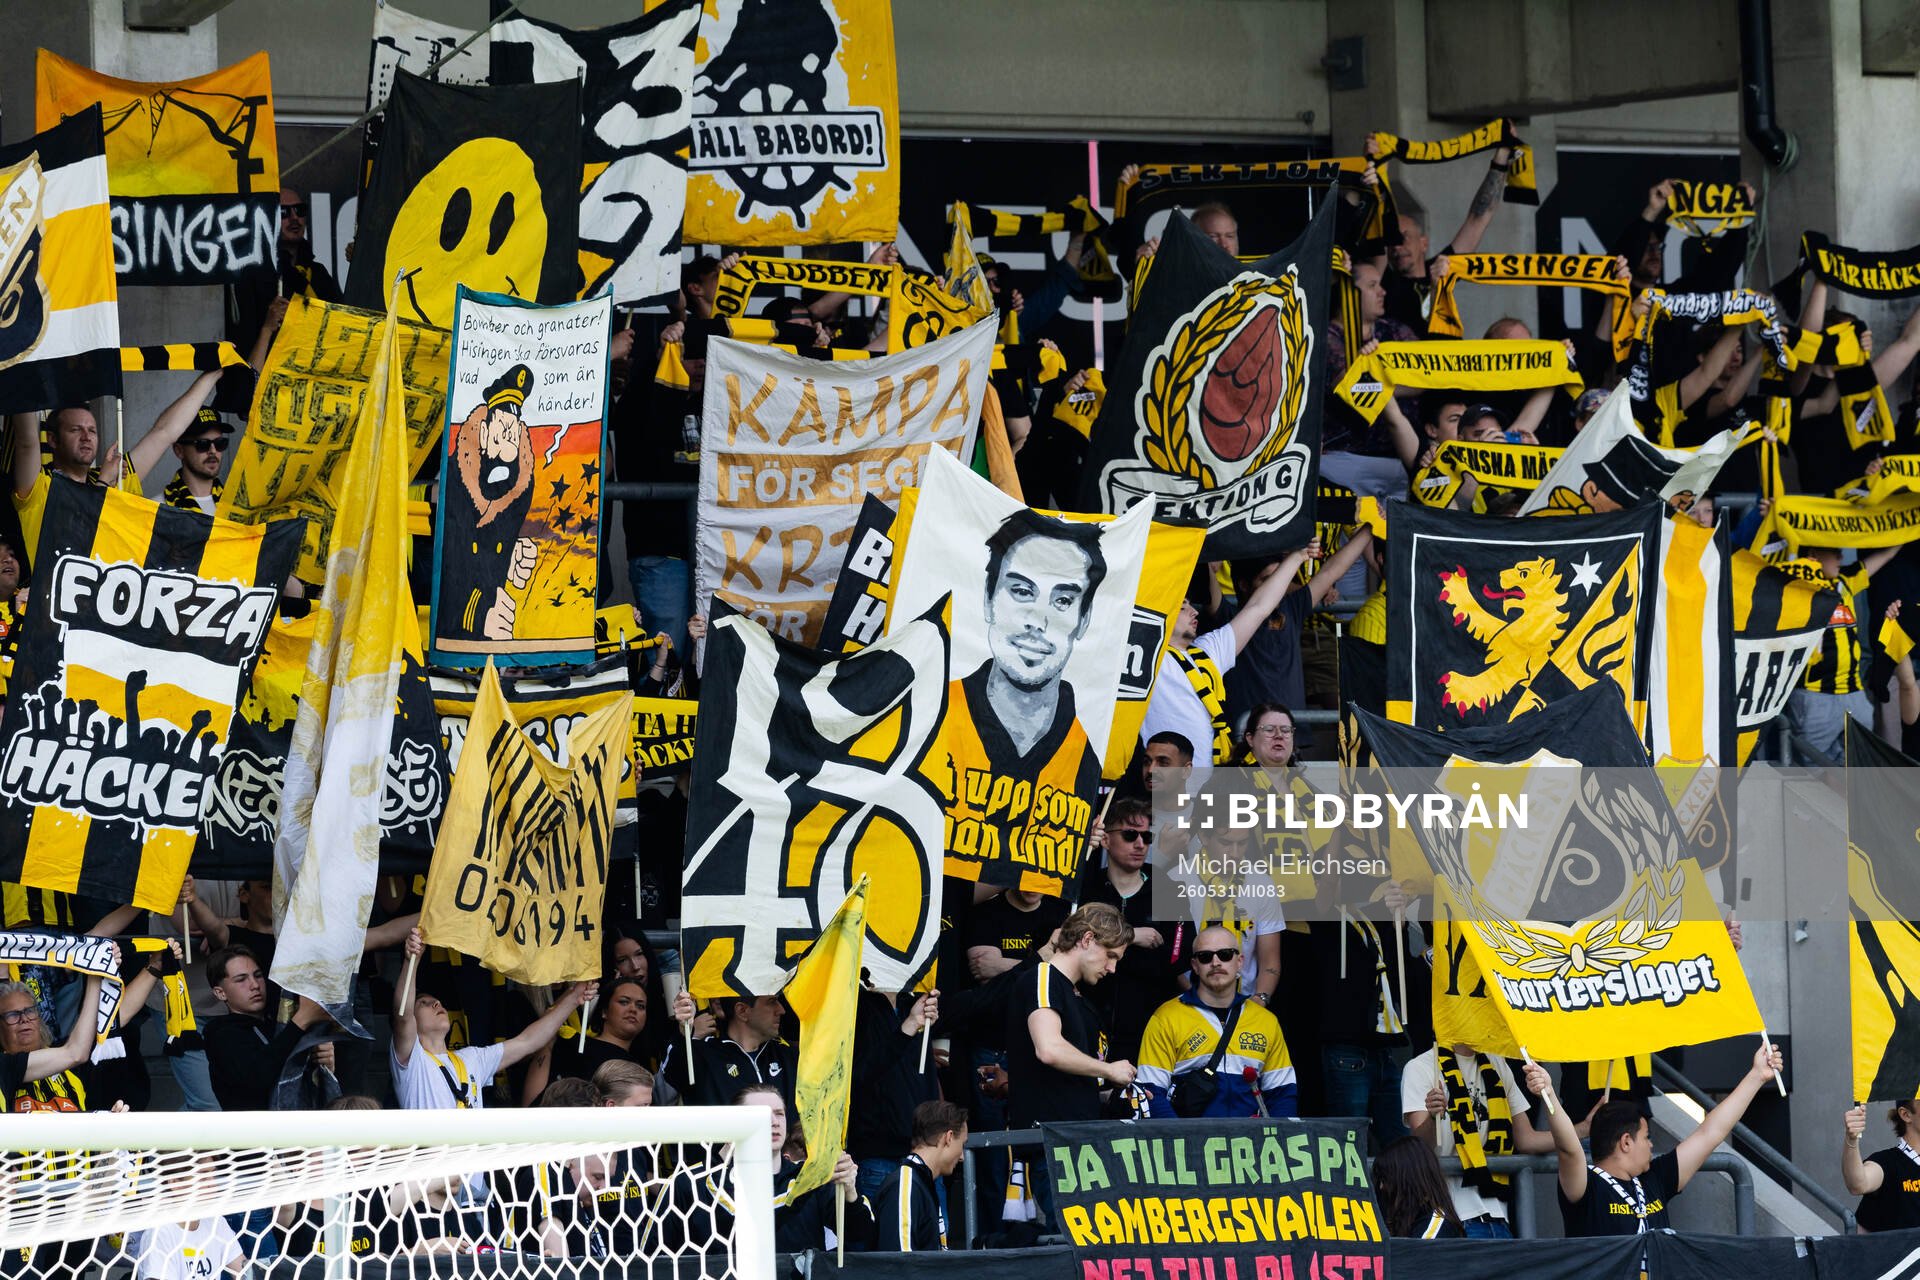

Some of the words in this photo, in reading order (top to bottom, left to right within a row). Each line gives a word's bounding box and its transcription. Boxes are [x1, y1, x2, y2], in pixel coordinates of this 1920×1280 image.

[753, 124, 874, 156] BABORD!
[1138, 161, 1341, 189] SEKTION
[1465, 255, 1618, 281] HISINGEN
[715, 259, 892, 319] OLLKLUBBEN
[463, 314, 510, 334] Bomber
[513, 319, 534, 336] och
[537, 309, 604, 340] granater!
[461, 339, 512, 366] Hisingen
[535, 340, 600, 361] försvaras
[459, 367, 480, 385] vad
[543, 372, 569, 386] som
[576, 366, 596, 381] än
[538, 392, 595, 412] händer!
[724, 358, 971, 447] KÄMPA
[728, 461, 816, 503] FÖR
[60, 560, 274, 649] FORZA
[966, 769, 1032, 823] upp
[1033, 785, 1092, 835] som
[1009, 823, 1085, 879] Lind!
[1053, 1144, 1111, 1193] JA
[1111, 1137, 1198, 1185] TILL
[1203, 1126, 1315, 1185] GRÄS
[1318, 1130, 1369, 1188] PÅ
[1255, 1251, 1384, 1280] PLST!
